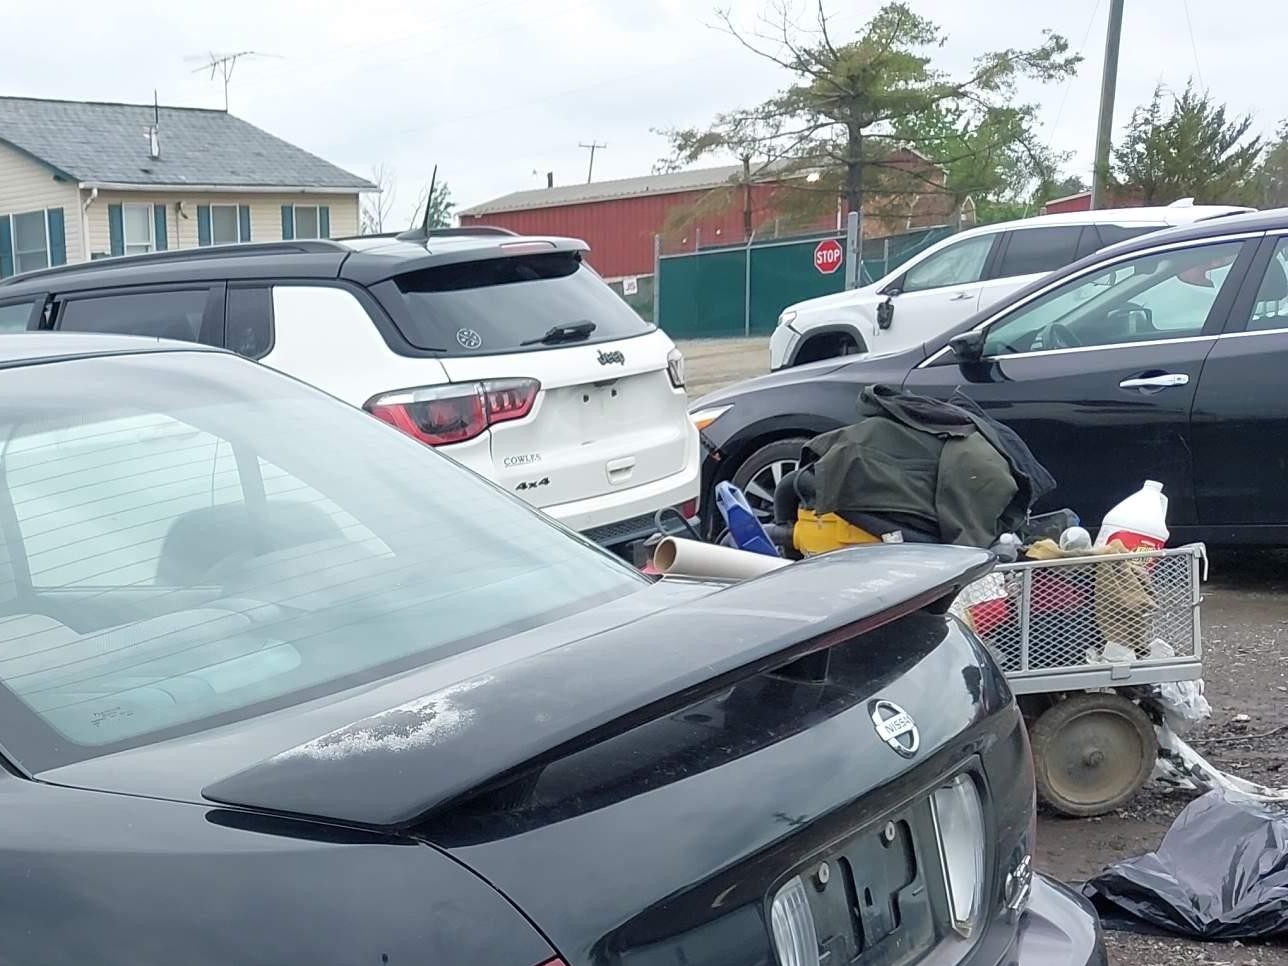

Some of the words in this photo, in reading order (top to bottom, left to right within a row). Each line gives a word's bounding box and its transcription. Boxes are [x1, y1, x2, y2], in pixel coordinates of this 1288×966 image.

[817, 249, 840, 264] STOP
[597, 349, 624, 366] Jeep
[515, 477, 550, 490] 4x4
